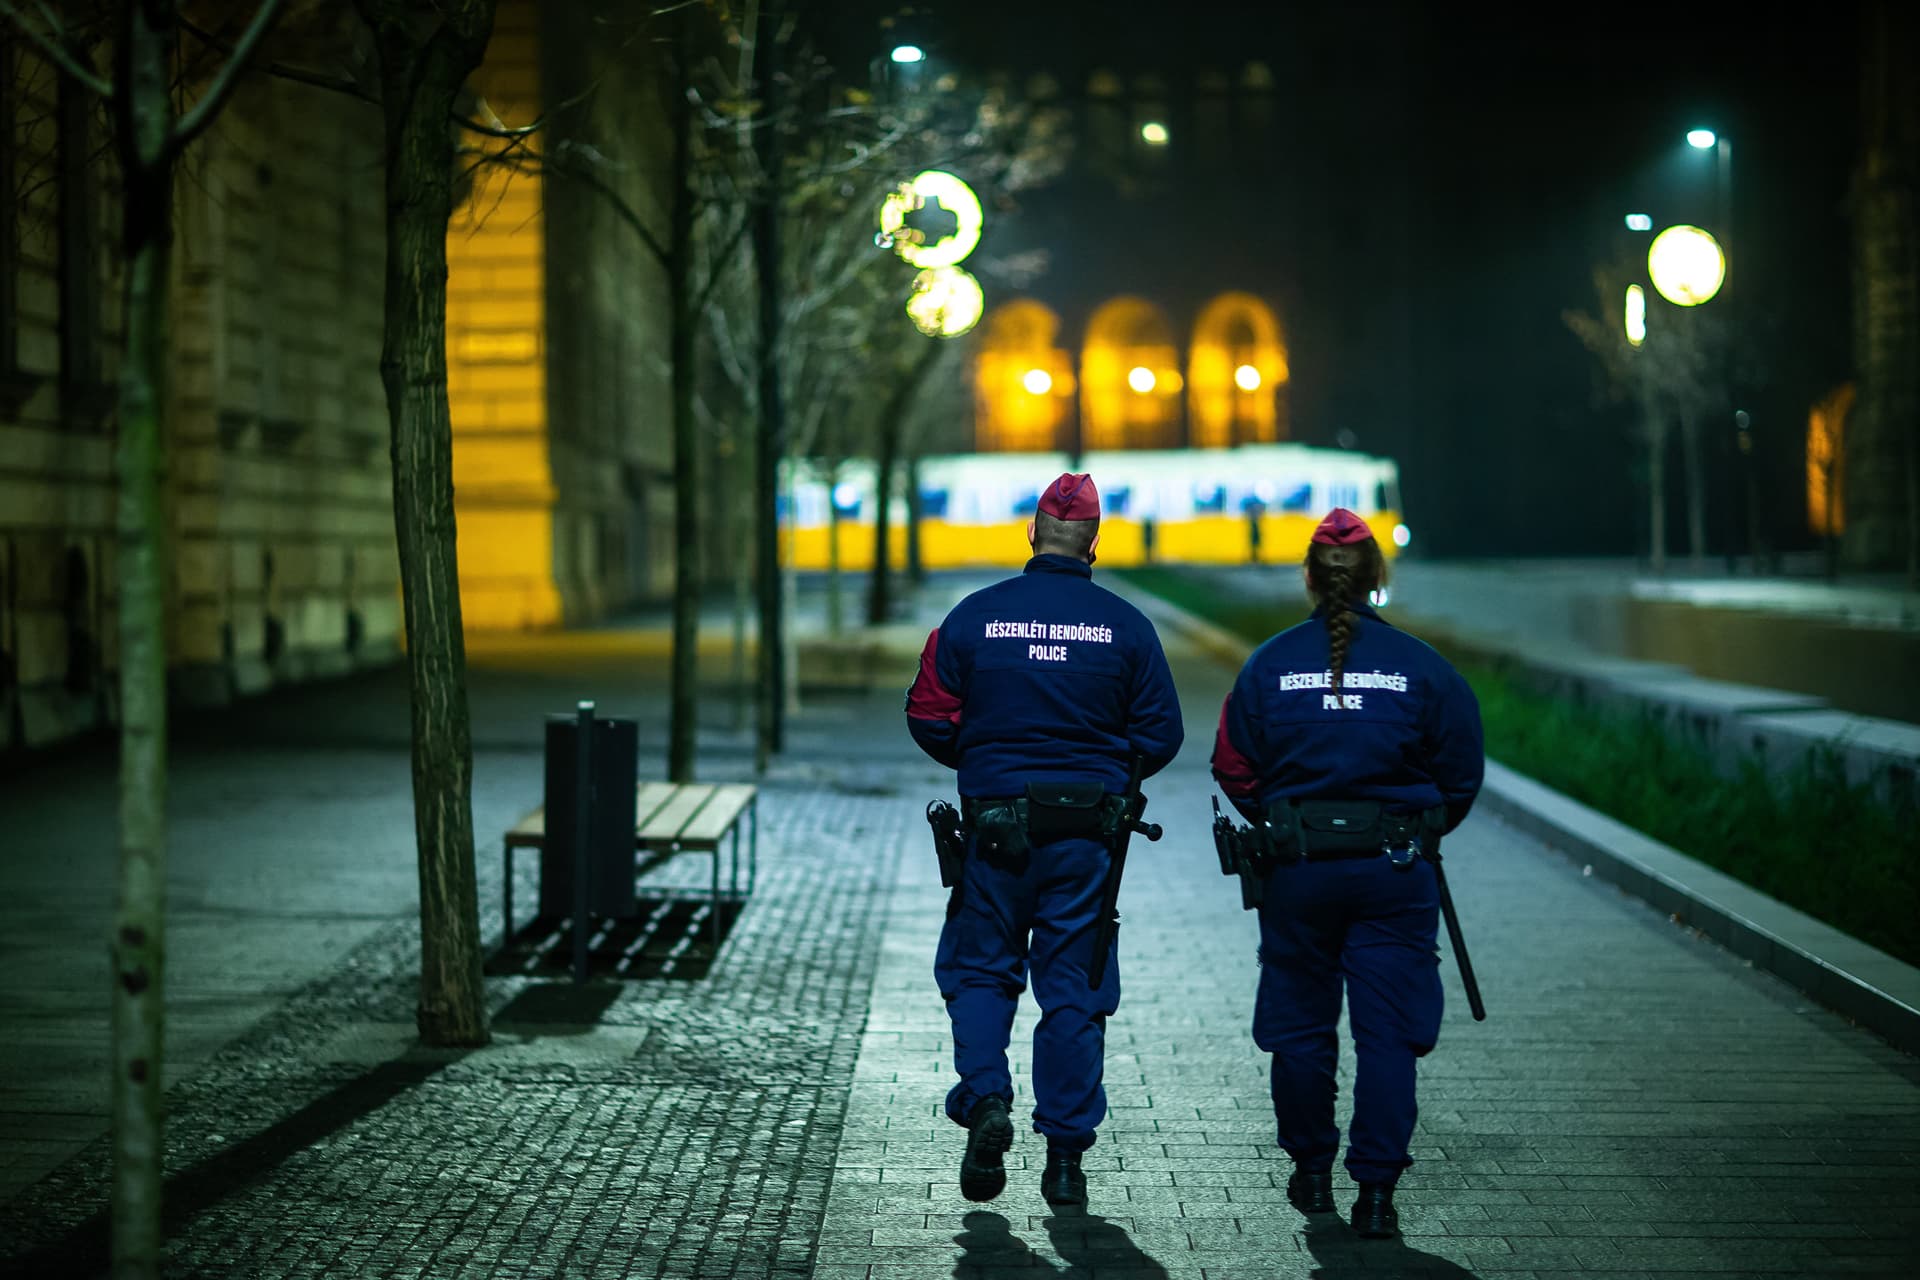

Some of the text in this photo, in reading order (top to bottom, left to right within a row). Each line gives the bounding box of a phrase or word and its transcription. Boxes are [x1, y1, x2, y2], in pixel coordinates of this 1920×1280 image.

[985, 619, 1047, 639] KÉSZENLÉTI
[1028, 644, 1068, 661] POLICE
[1279, 668, 1341, 691] KÉSZENLÉ
[1322, 694, 1363, 710] POICE
